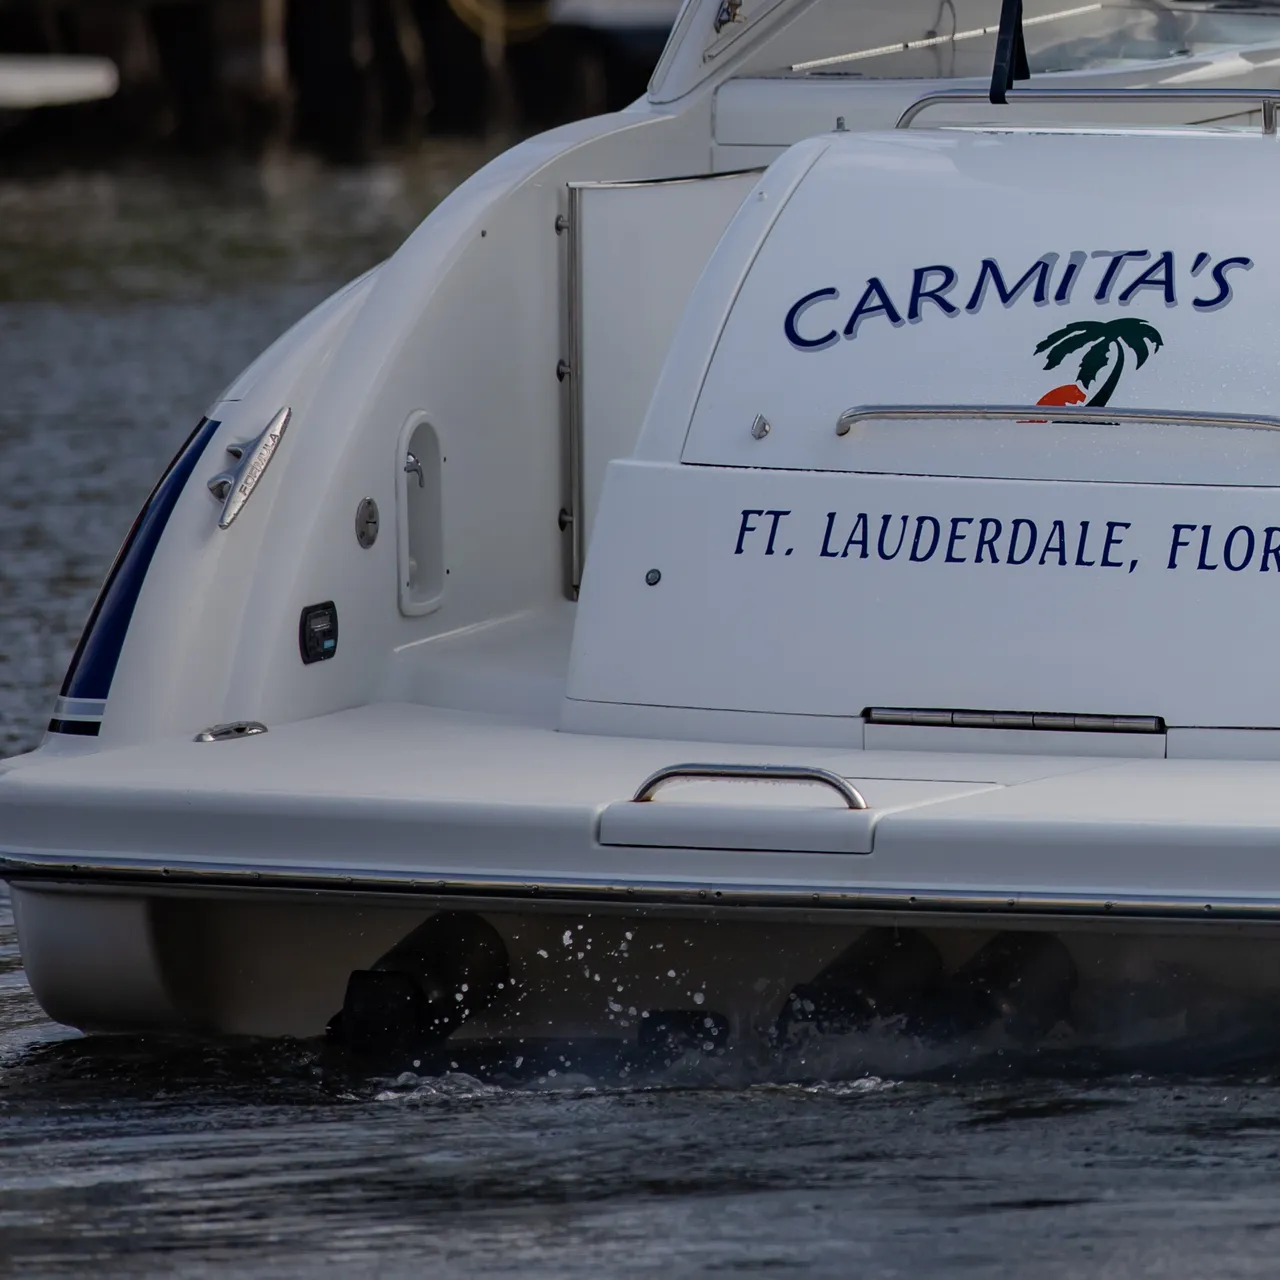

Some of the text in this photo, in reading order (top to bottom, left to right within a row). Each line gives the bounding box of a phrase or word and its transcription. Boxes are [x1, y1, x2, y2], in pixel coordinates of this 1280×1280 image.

[784, 250, 1254, 351] CARMITA'S
[239, 433, 279, 496] FORMULA
[735, 510, 794, 557] FT.
[820, 512, 1139, 574] LAUDERDALE,
